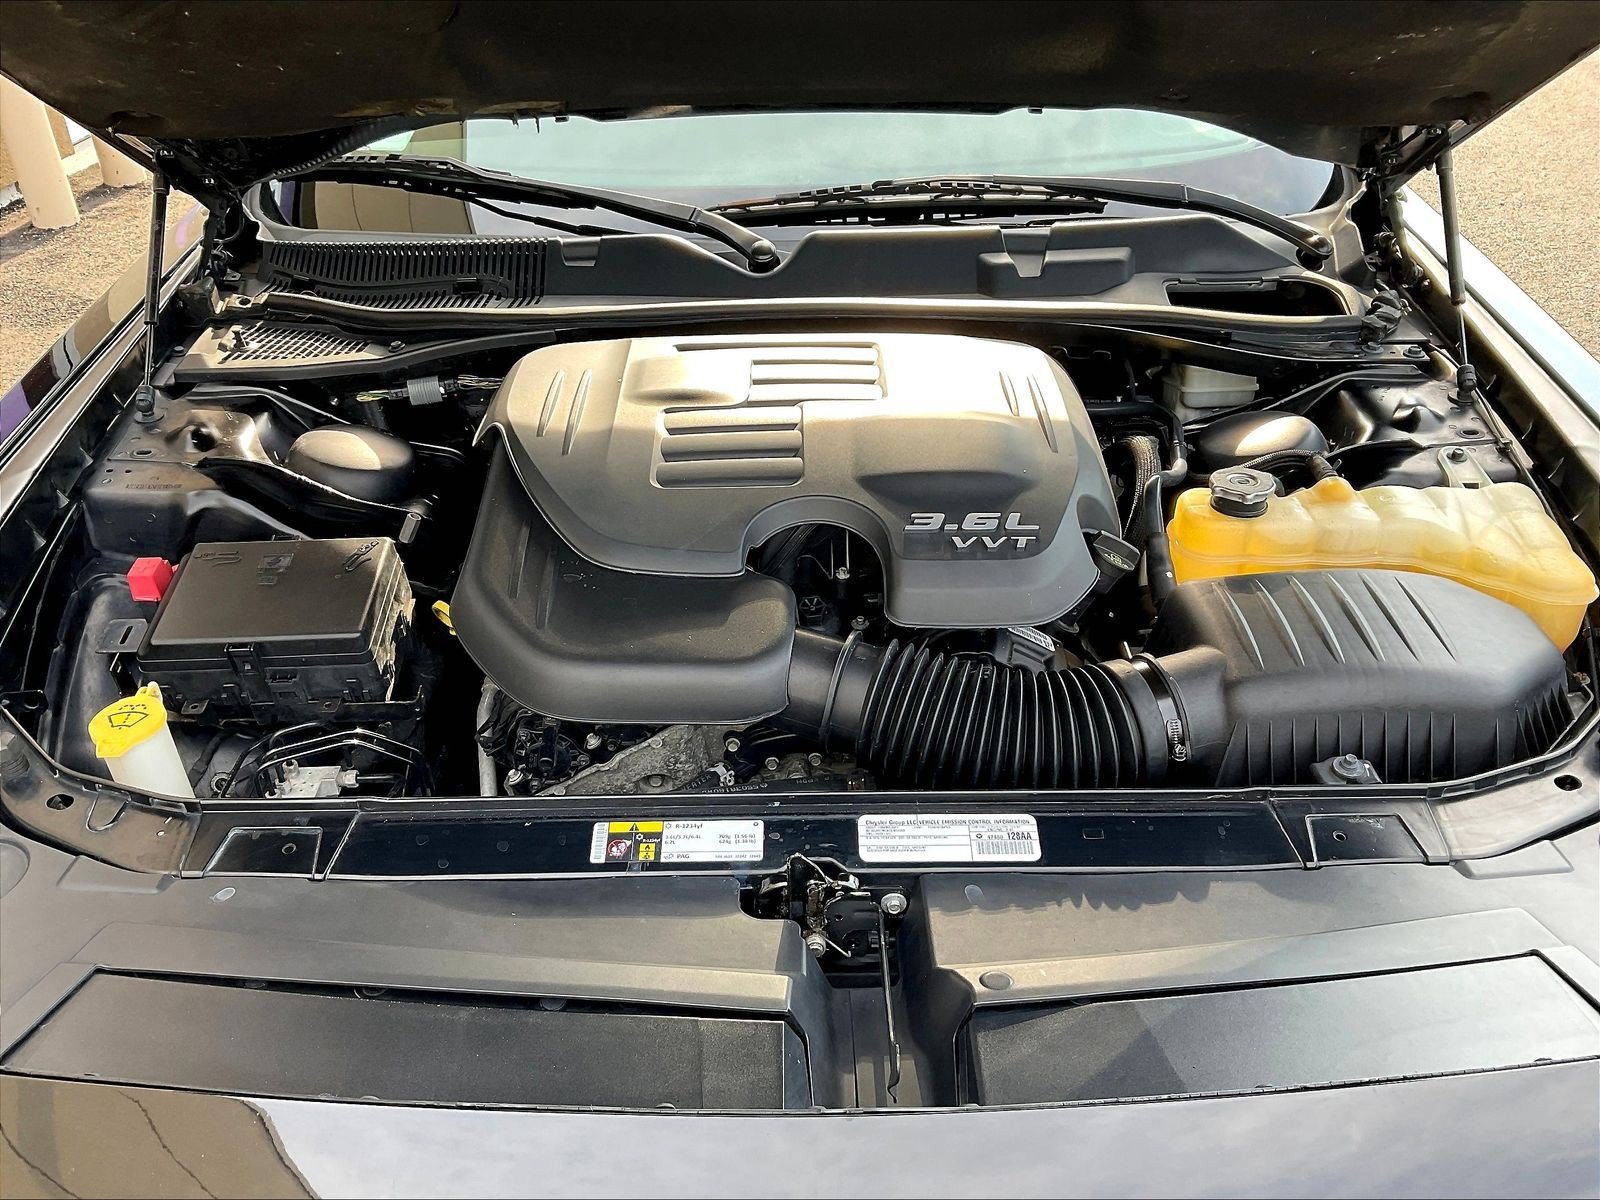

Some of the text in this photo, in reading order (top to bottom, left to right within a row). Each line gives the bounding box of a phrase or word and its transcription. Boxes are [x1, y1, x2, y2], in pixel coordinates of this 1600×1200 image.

[903, 512, 1040, 532] 3.6L
[951, 536, 1037, 550] VVT
[1007, 831, 1032, 840] 128AA
